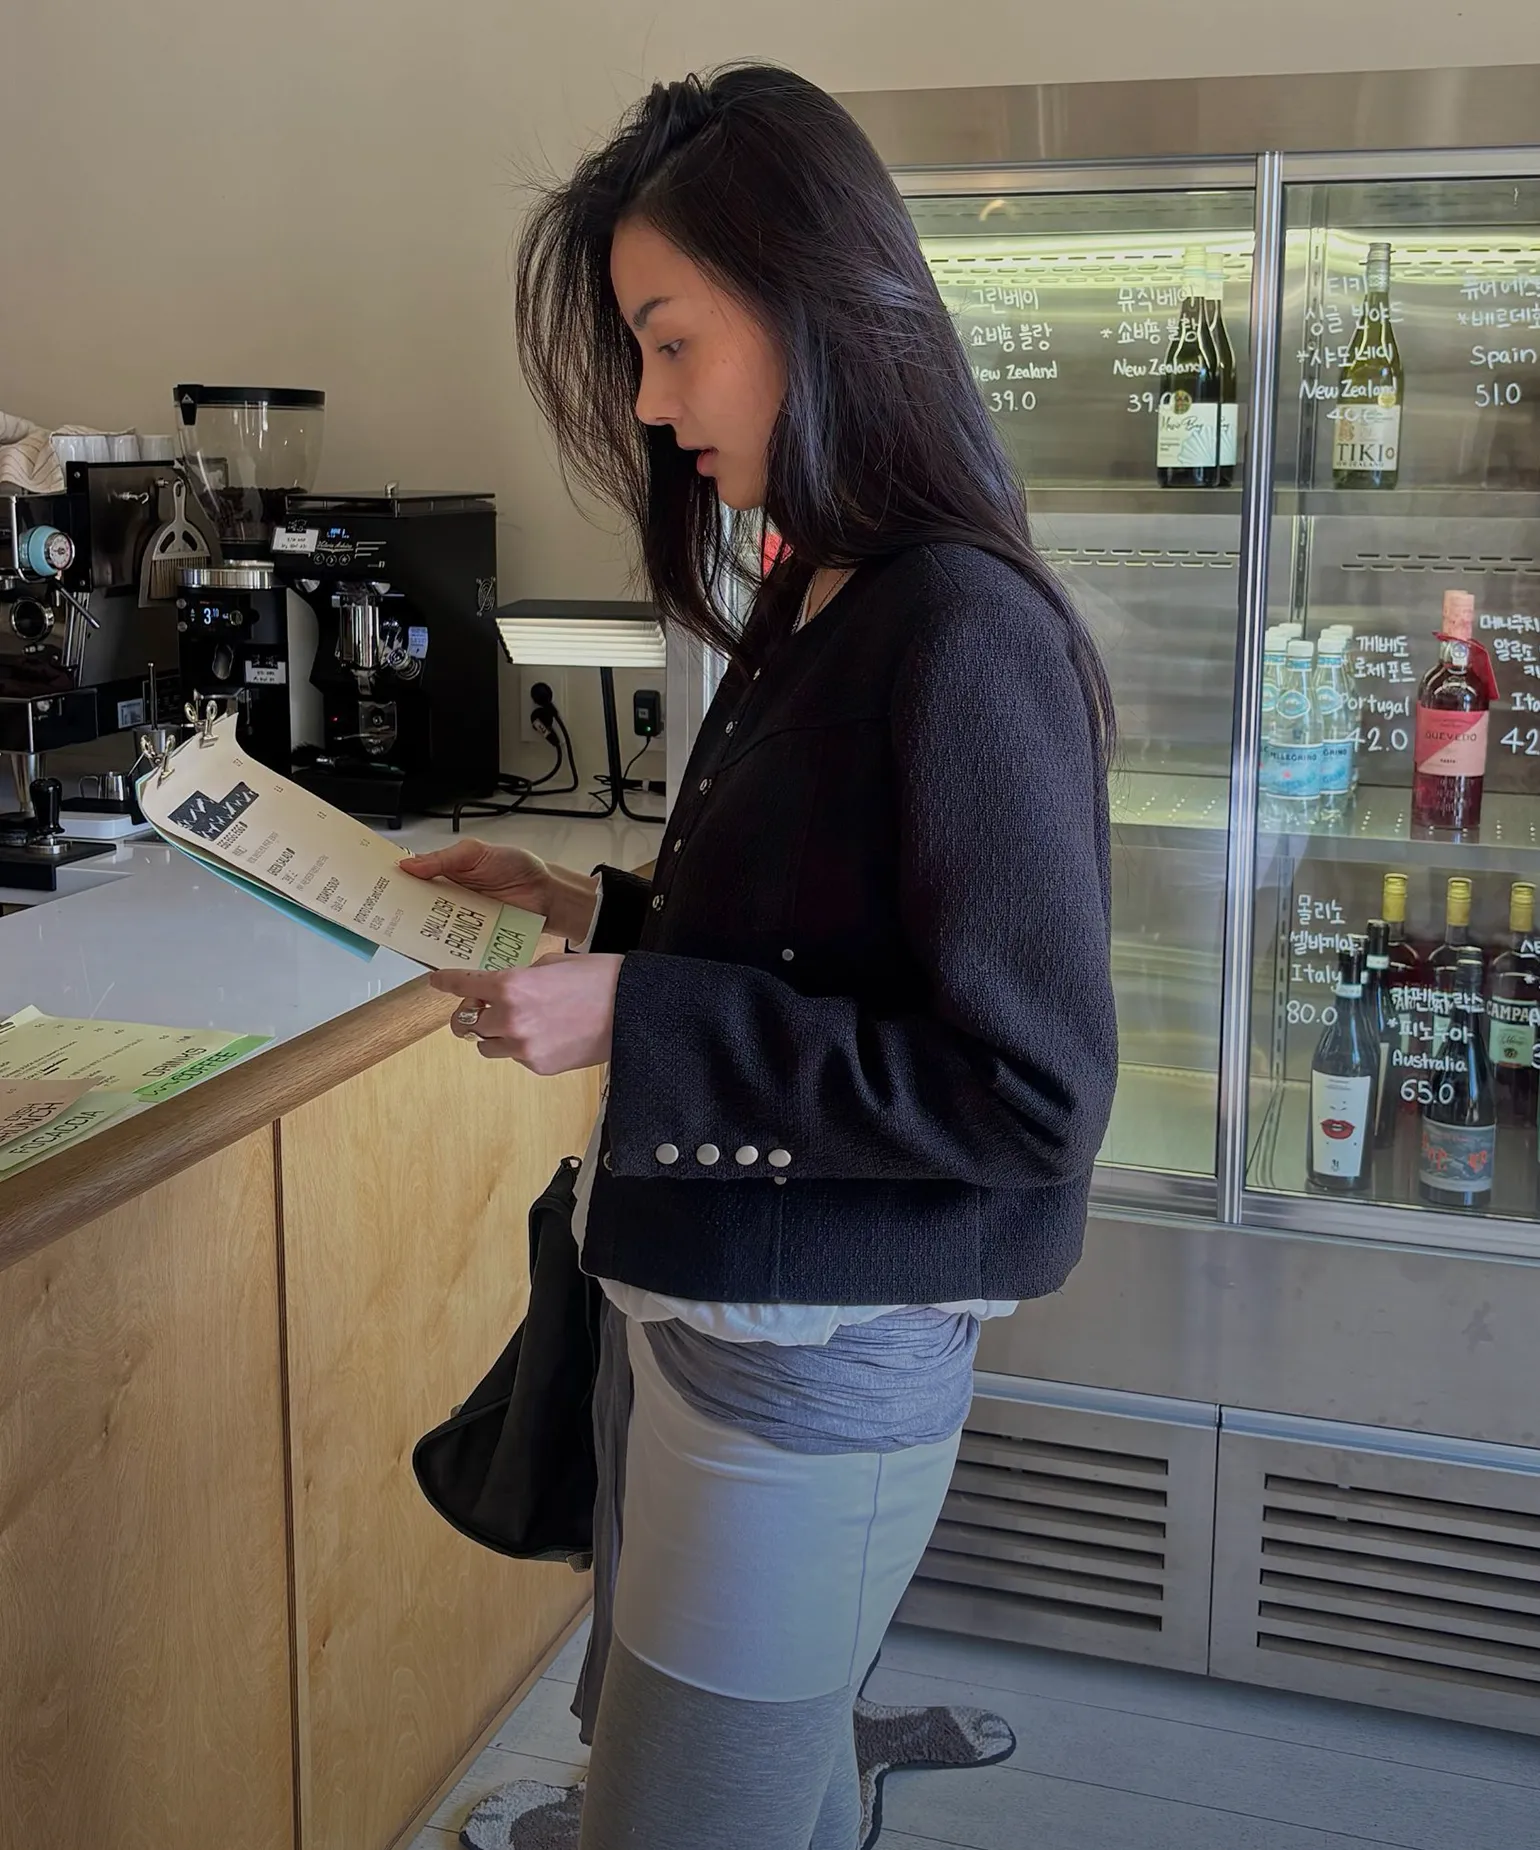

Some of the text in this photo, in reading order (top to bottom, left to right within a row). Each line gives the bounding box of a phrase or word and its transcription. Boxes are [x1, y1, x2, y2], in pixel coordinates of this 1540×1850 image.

[1117, 285, 1195, 313] 뮤직베이
[1305, 301, 1404, 337] 싱글 빈야드
[1019, 322, 1053, 351] 블랑
[1005, 360, 1058, 380] Zealand
[1112, 355, 1203, 378] New Zealand
[1470, 345, 1538, 369] Spain
[988, 390, 1037, 412] 39.0
[1299, 376, 1398, 400] New Zealand
[1474, 382, 1521, 407] 51.0
[1341, 693, 1409, 720] Portugal
[1344, 726, 1408, 752] 42.0
[1425, 731, 1477, 742] QUEVEDO
[420, 896, 456, 941] SMALL DISH
[1297, 894, 1345, 925] 몰리노
[444, 906, 487, 954] BRUNCH
[1291, 963, 1342, 992] Italy
[1287, 1000, 1338, 1026] 80.0
[1399, 1021, 1474, 1044] 피노누아
[141, 1047, 207, 1077] DRINKS
[171, 1051, 238, 1081] COFFEE
[1392, 1049, 1468, 1072] Australia
[1400, 1079, 1455, 1104] 65.0
[8, 1110, 105, 1154] FOCACCIA
